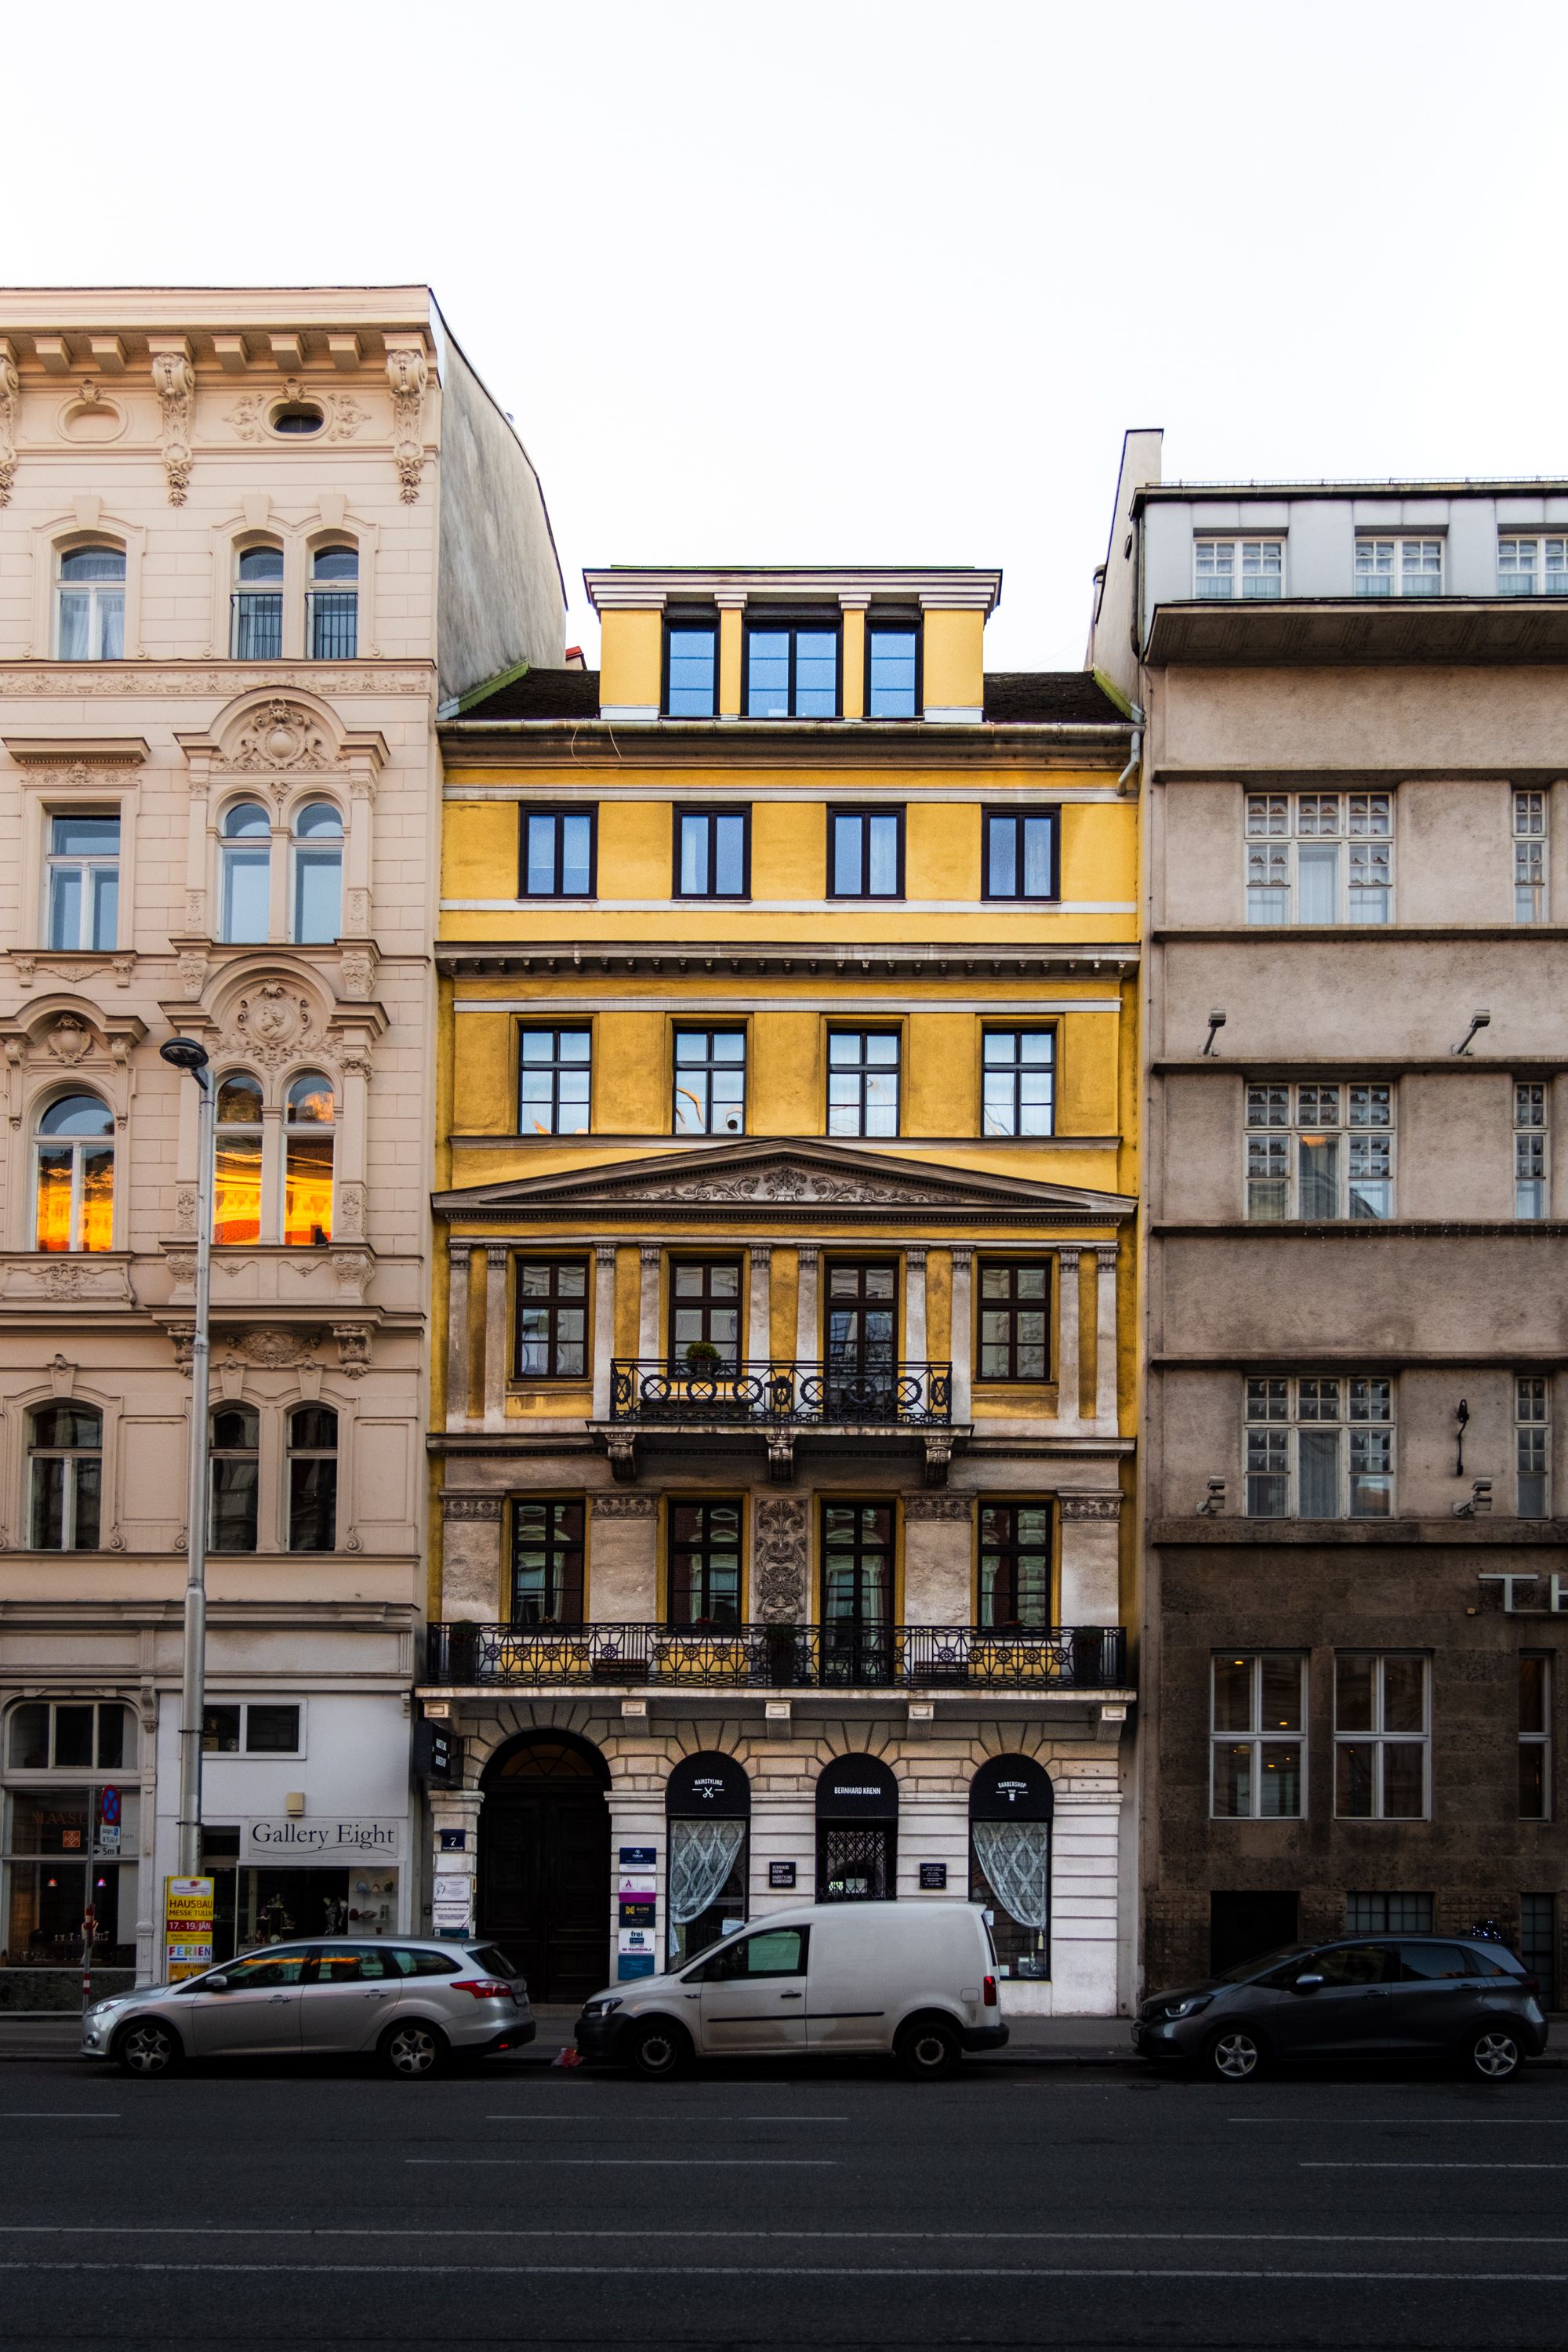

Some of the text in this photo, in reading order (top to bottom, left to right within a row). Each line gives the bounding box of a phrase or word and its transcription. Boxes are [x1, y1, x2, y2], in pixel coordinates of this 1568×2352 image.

[252, 1823, 395, 1849] Gallery Eight
[449, 1837, 457, 1846] 7
[103, 1847, 114, 1856] 5m
[169, 1947, 211, 1956] FERIEN
